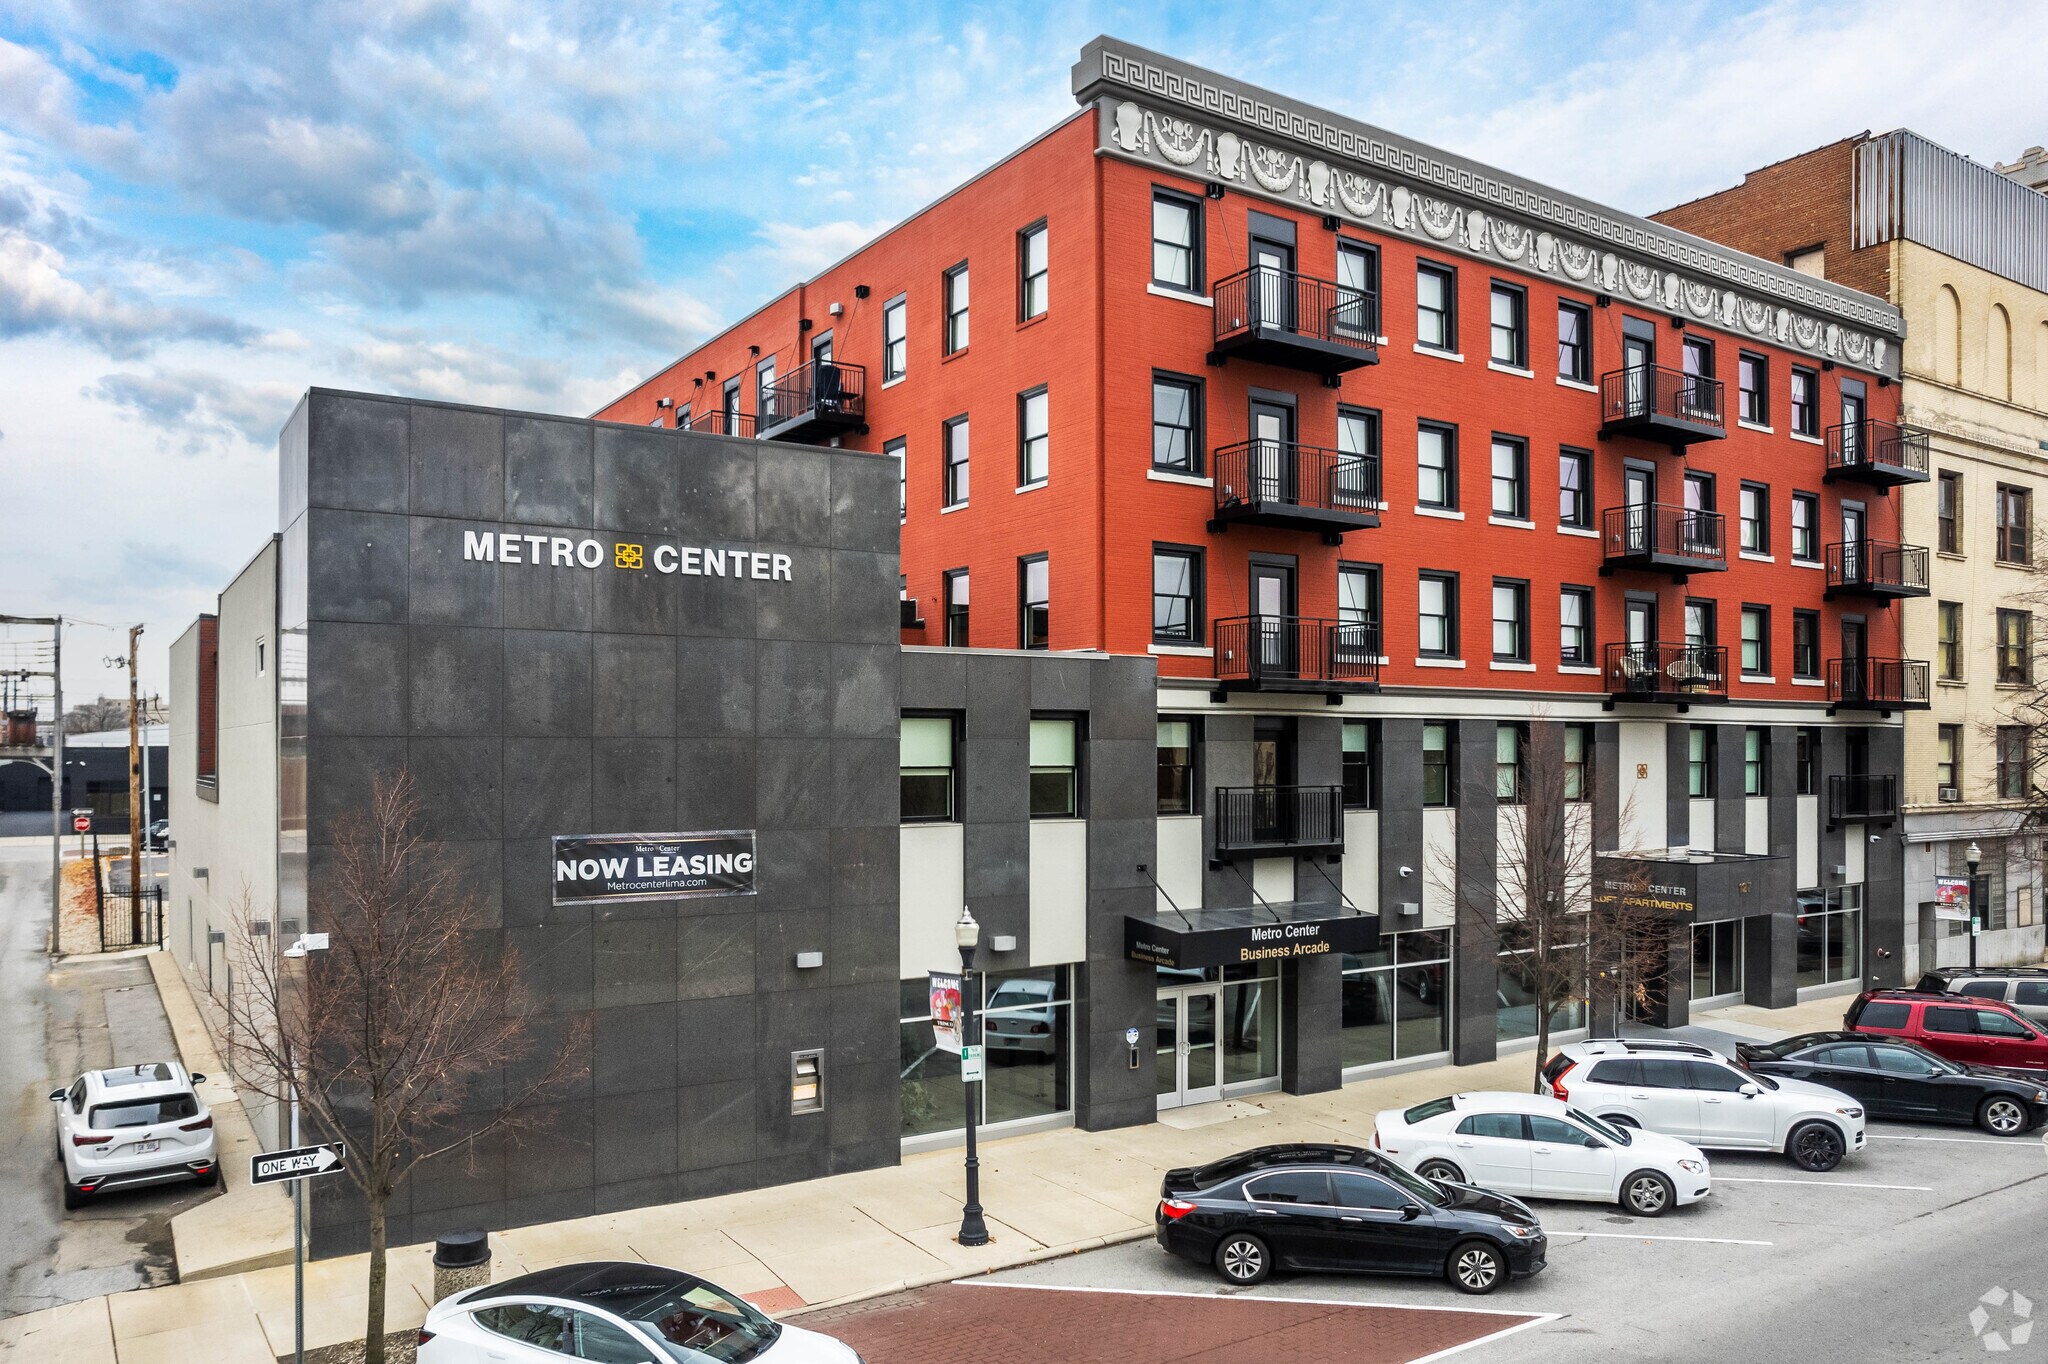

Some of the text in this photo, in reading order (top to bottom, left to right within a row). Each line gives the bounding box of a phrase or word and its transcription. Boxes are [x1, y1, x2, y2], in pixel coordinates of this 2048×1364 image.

[463, 529, 793, 582] METRO CENTER
[659, 844, 680, 852] Center
[557, 852, 753, 881] NOW LEASING
[607, 877, 707, 891] Metrocenterlima.com
[1604, 880, 1686, 896] METRO CENTER
[1938, 878, 1967, 886] WELCOME
[1622, 897, 1693, 911] APARTMENTS
[1251, 924, 1320, 941] Metro Center
[1135, 941, 1170, 954] Metro Center
[1240, 941, 1330, 961] Business Arcade
[1130, 950, 1175, 967] Business Arcade
[931, 977, 959, 990] WELCOME
[262, 1154, 318, 1175] ONE WAY
